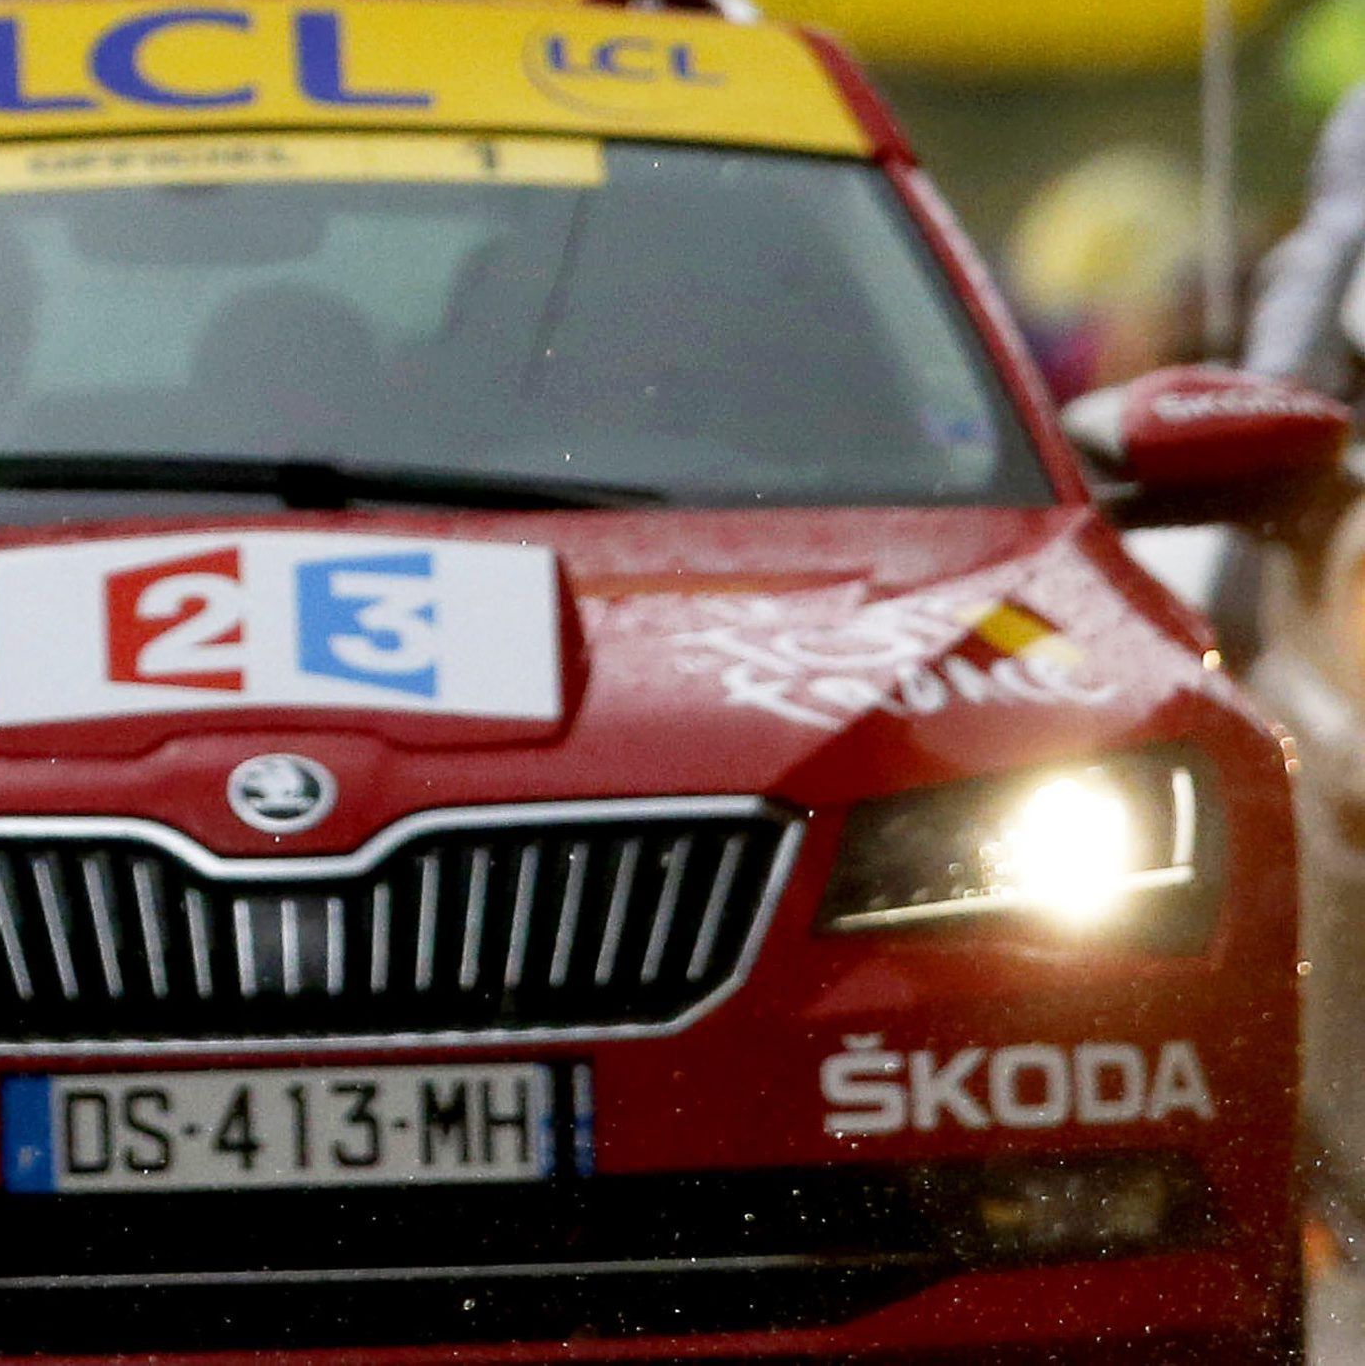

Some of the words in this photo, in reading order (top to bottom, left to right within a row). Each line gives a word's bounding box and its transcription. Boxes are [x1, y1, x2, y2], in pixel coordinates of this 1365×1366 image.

[541, 32, 725, 86] LCL
[135, 570, 246, 678] 2
[327, 570, 436, 676] 3
[63, 1077, 529, 1175] DS-413-MH
[820, 1034, 1213, 1135] ŠKODA
